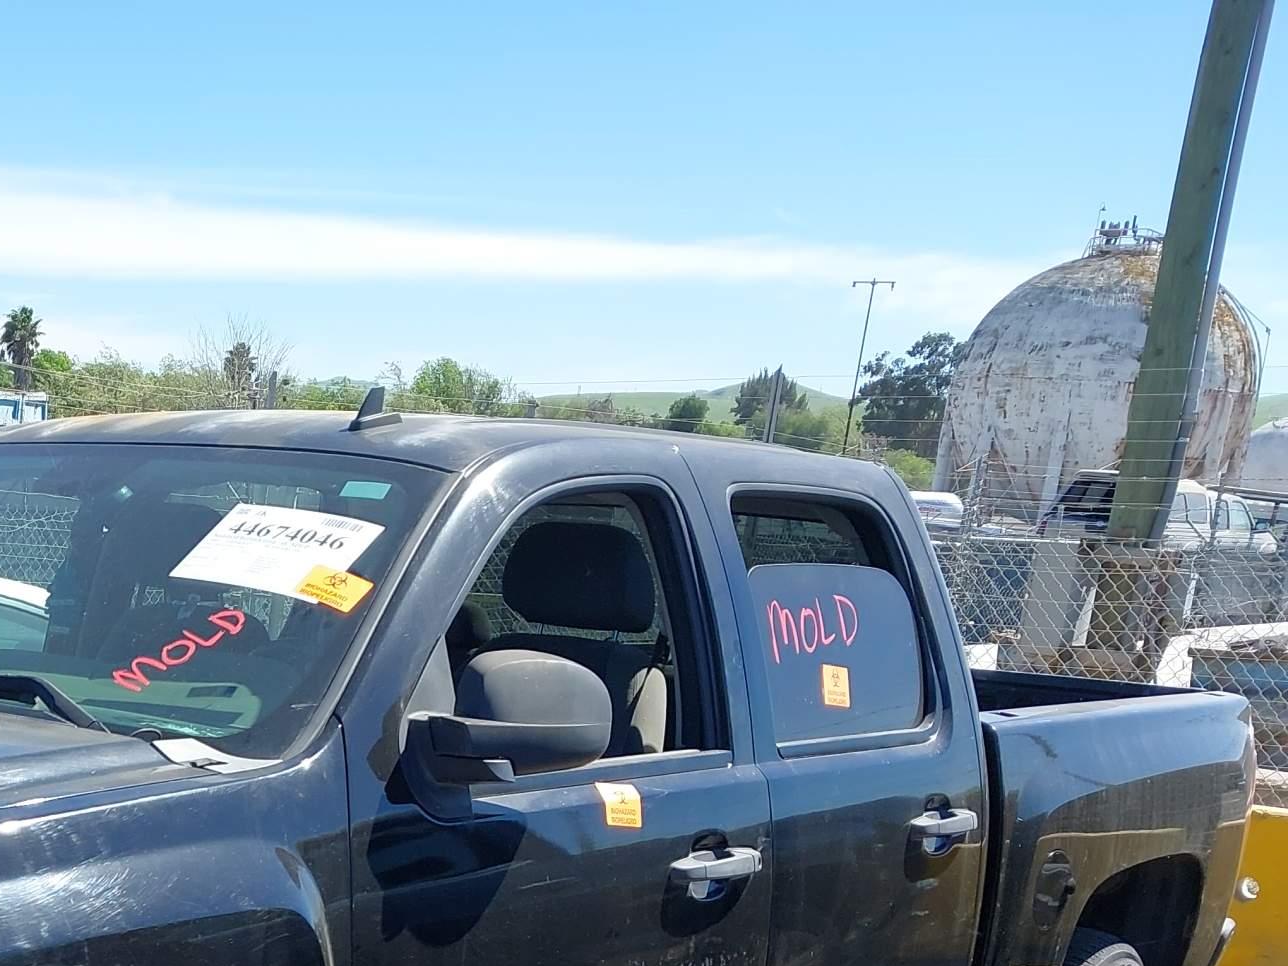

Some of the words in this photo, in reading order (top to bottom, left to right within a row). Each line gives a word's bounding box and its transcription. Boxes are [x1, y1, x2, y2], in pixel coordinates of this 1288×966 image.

[229, 521, 349, 550] 44674046
[112, 608, 247, 693] MOLD
[766, 594, 858, 665] MOLD
